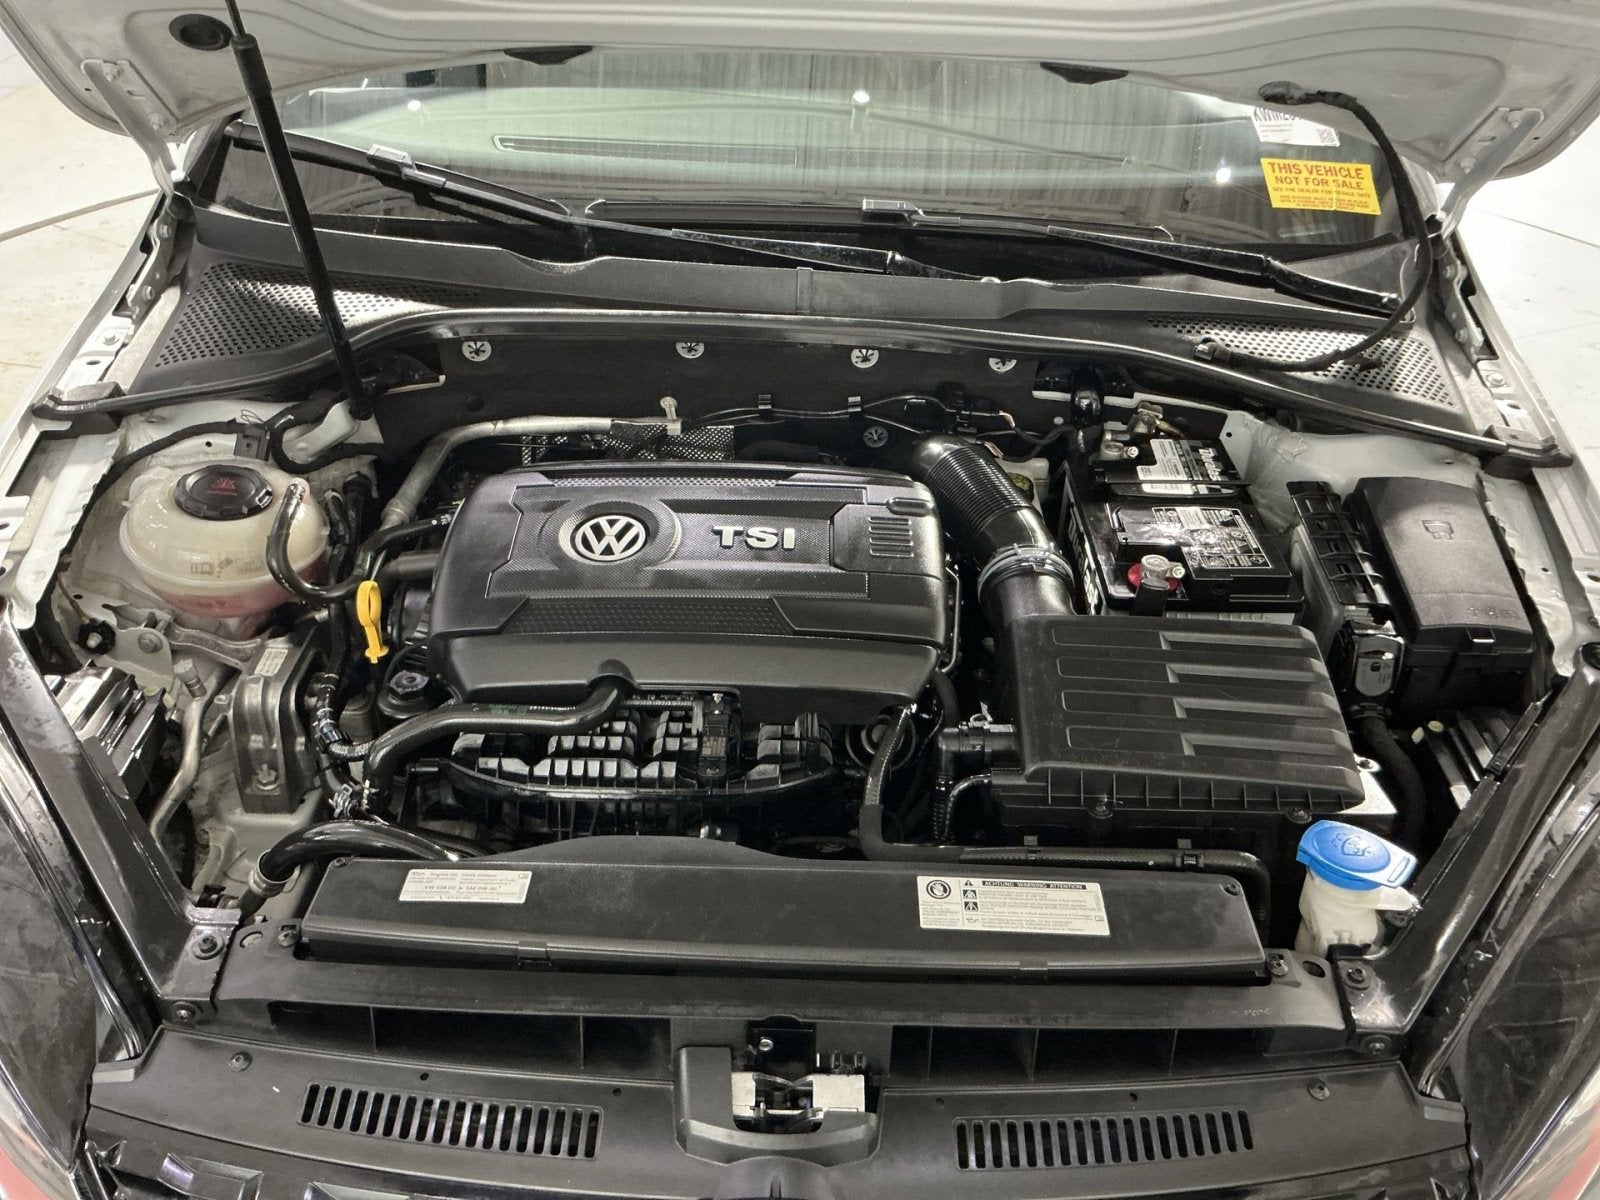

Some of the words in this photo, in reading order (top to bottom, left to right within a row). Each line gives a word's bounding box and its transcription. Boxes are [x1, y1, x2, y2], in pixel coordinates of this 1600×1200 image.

[1268, 162, 1301, 175] THIS
[1304, 164, 1364, 181] VEHICLE
[1275, 176, 1300, 186] NOT
[1304, 177, 1329, 188] FOR
[1333, 179, 1364, 191] SALE
[1198, 447, 1222, 481] Duralas
[575, 514, 647, 562] VW
[713, 525, 796, 551] TSI
[984, 880, 1015, 888] ACHTUNG
[1049, 883, 1083, 891] ATTENTION
